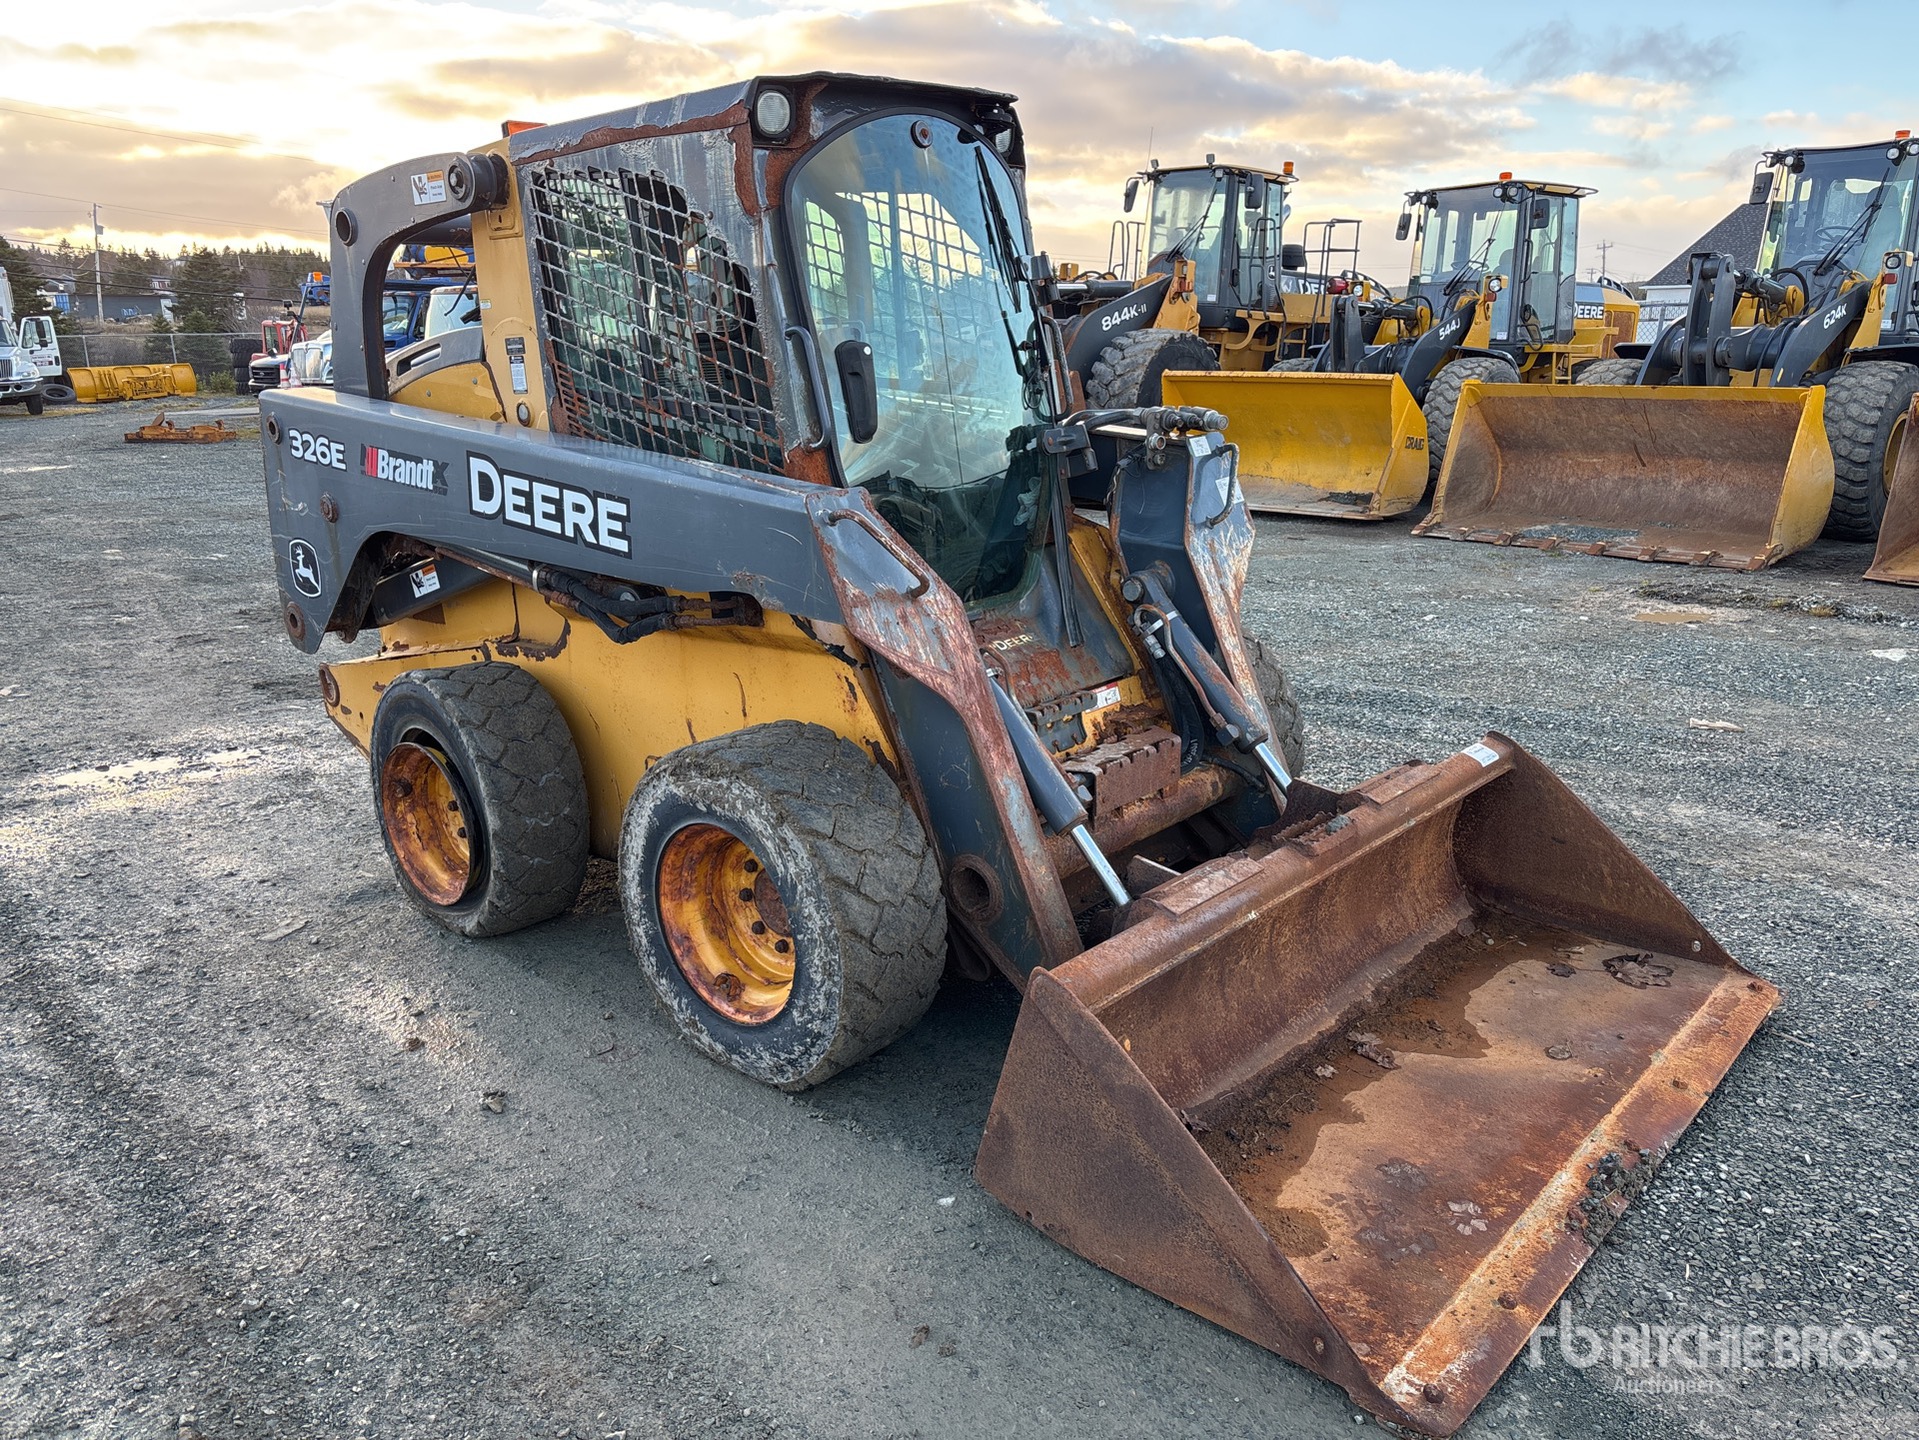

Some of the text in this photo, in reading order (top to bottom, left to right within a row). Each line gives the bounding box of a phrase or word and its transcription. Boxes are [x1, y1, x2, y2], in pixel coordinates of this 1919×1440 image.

[1439, 318, 1461, 341] 544J
[1823, 303, 1847, 329] 624K
[288, 429, 347, 471] 326E
[377, 448, 434, 490] Brandt
[469, 456, 629, 553] DEERE
